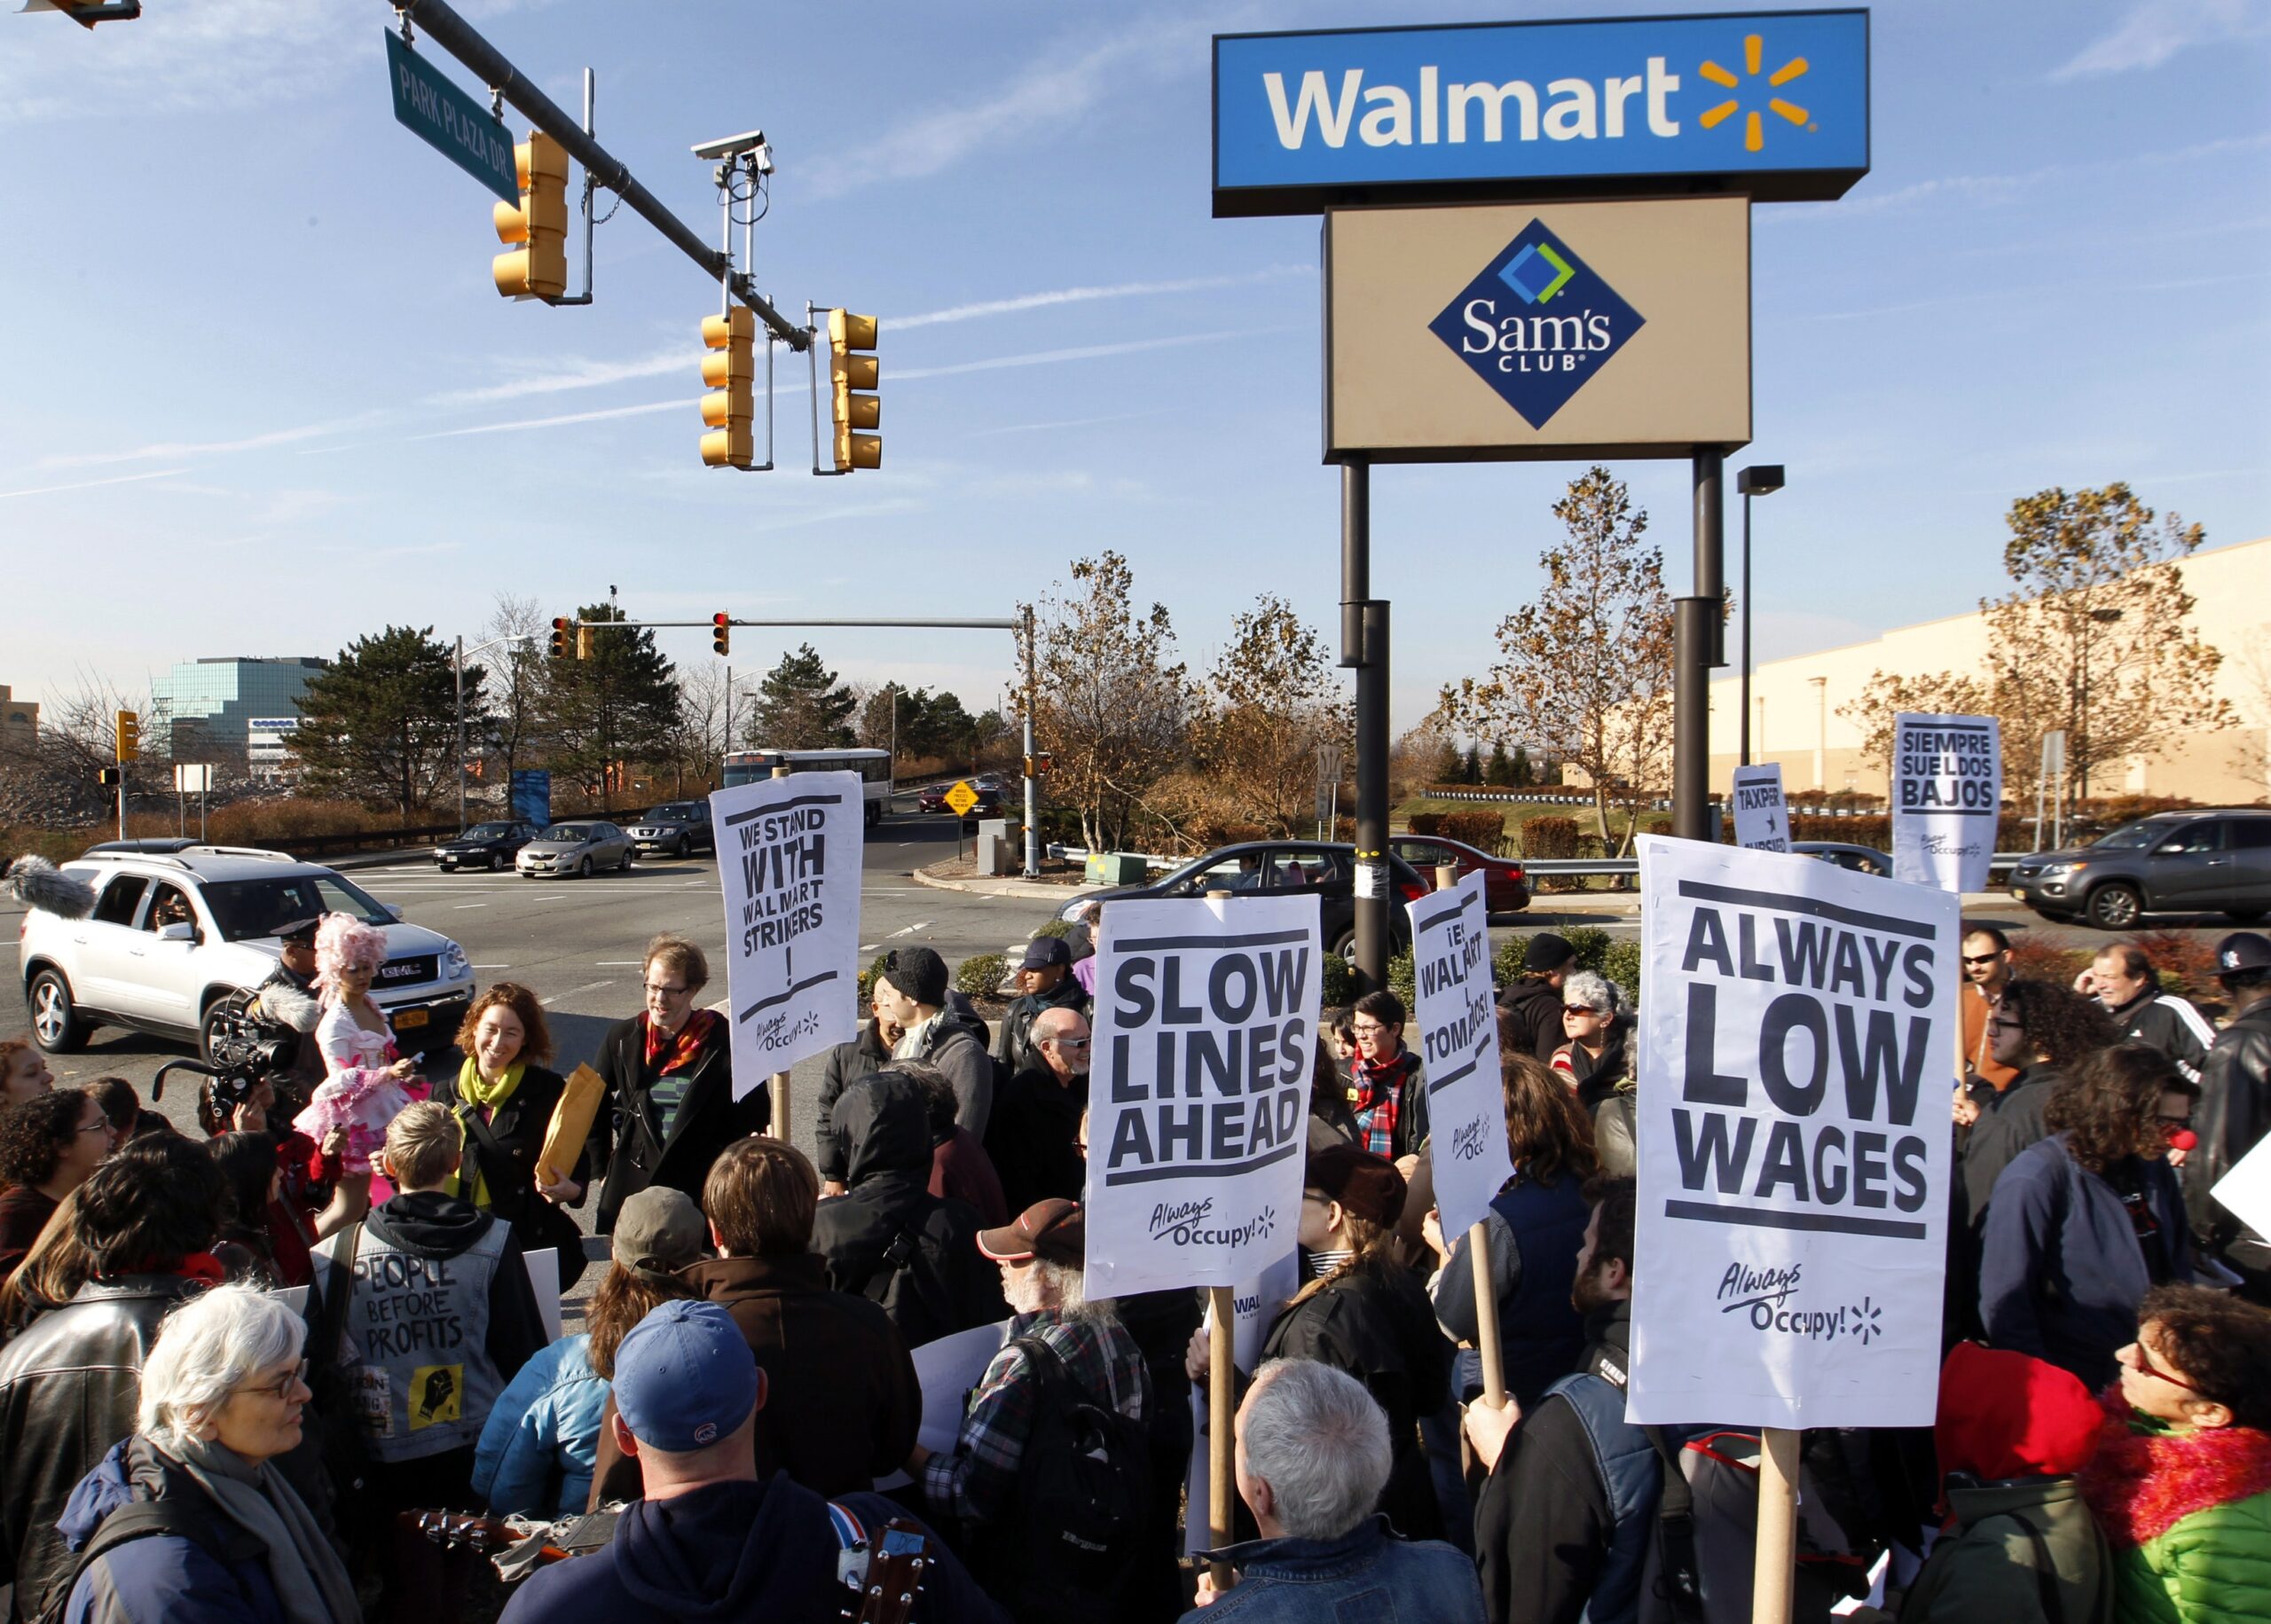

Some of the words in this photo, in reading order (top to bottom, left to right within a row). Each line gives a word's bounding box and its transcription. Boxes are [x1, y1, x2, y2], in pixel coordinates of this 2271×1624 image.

[399, 63, 441, 128] PARK
[444, 98, 488, 165] PLAZA
[490, 137, 512, 183] DR.
[1263, 56, 1681, 151] Walmart
[1464, 299, 1611, 353] Sam's
[1903, 731, 1991, 755] SIEMPRE
[1902, 755, 1992, 778] SUELDOS
[1901, 779, 1993, 808] BAJOS
[739, 822, 760, 851] WE
[764, 808, 825, 843] STAND
[742, 834, 825, 899] WITH
[743, 879, 823, 926] WALMART
[744, 903, 822, 958] STRIKERS
[381, 963, 422, 978] GMC
[785, 945, 791, 986] !
[1681, 906, 1935, 1009] ALWAYS
[1114, 947, 1309, 1029] SLOW
[1111, 1017, 1306, 1104] LINES
[1683, 981, 1931, 1127] LOW
[1107, 1087, 1301, 1169] AHEAD
[1671, 1107, 1928, 1213] WAGES
[1149, 1196, 1214, 1233] Always
[1173, 1218, 1256, 1248] Occupy!
[353, 1253, 457, 1296] PEOPLE
[1717, 1261, 1802, 1307] Always
[366, 1289, 453, 1323] BEFORE
[1750, 1300, 1845, 1341] Occupy!
[366, 1315, 463, 1360] PROFITS
